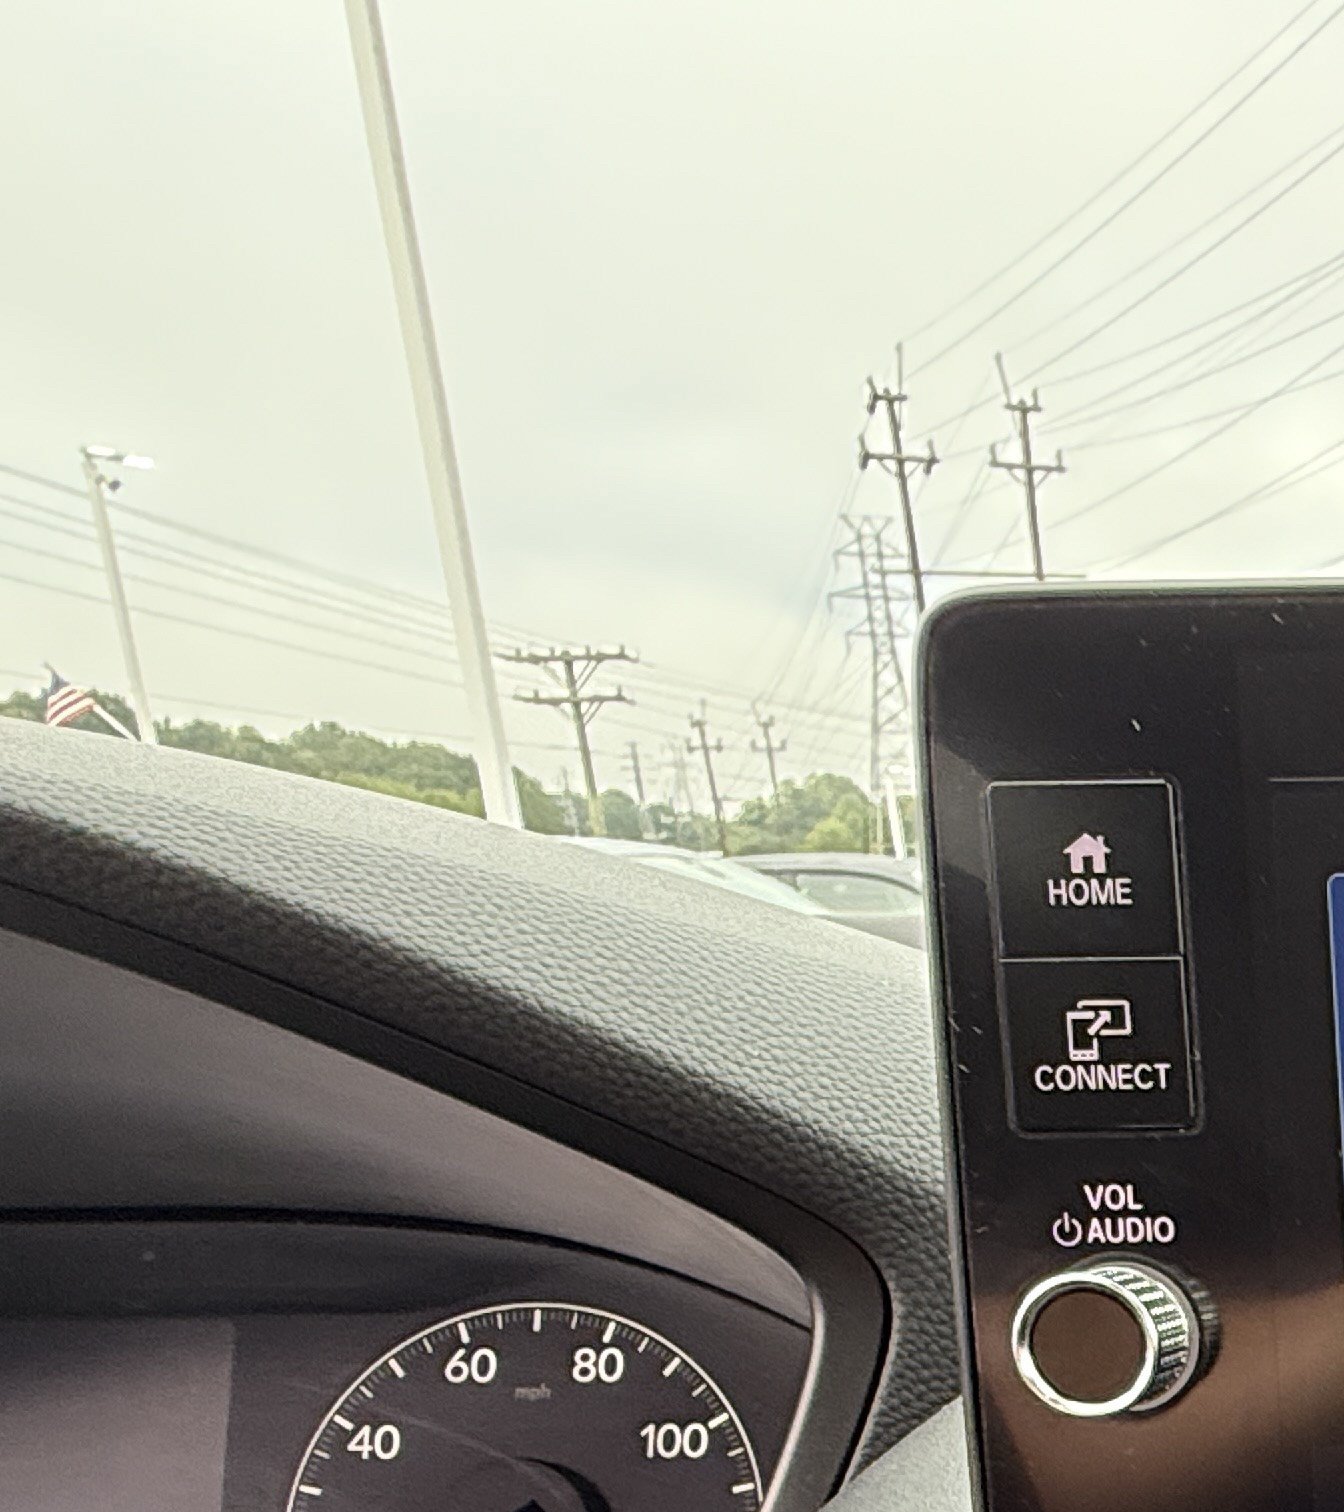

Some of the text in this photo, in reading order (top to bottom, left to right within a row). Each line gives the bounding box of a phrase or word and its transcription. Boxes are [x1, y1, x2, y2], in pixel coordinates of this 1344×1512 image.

[1047, 878, 1133, 906] HOME
[1034, 1063, 1171, 1091] CONNECT
[1083, 1184, 1143, 1211] VOL
[1088, 1216, 1175, 1244] AUDIO
[444, 1348, 498, 1384] 60
[572, 1347, 624, 1383] 80
[513, 1385, 552, 1401] mph
[345, 1422, 401, 1460] 40
[640, 1423, 711, 1459] 100
